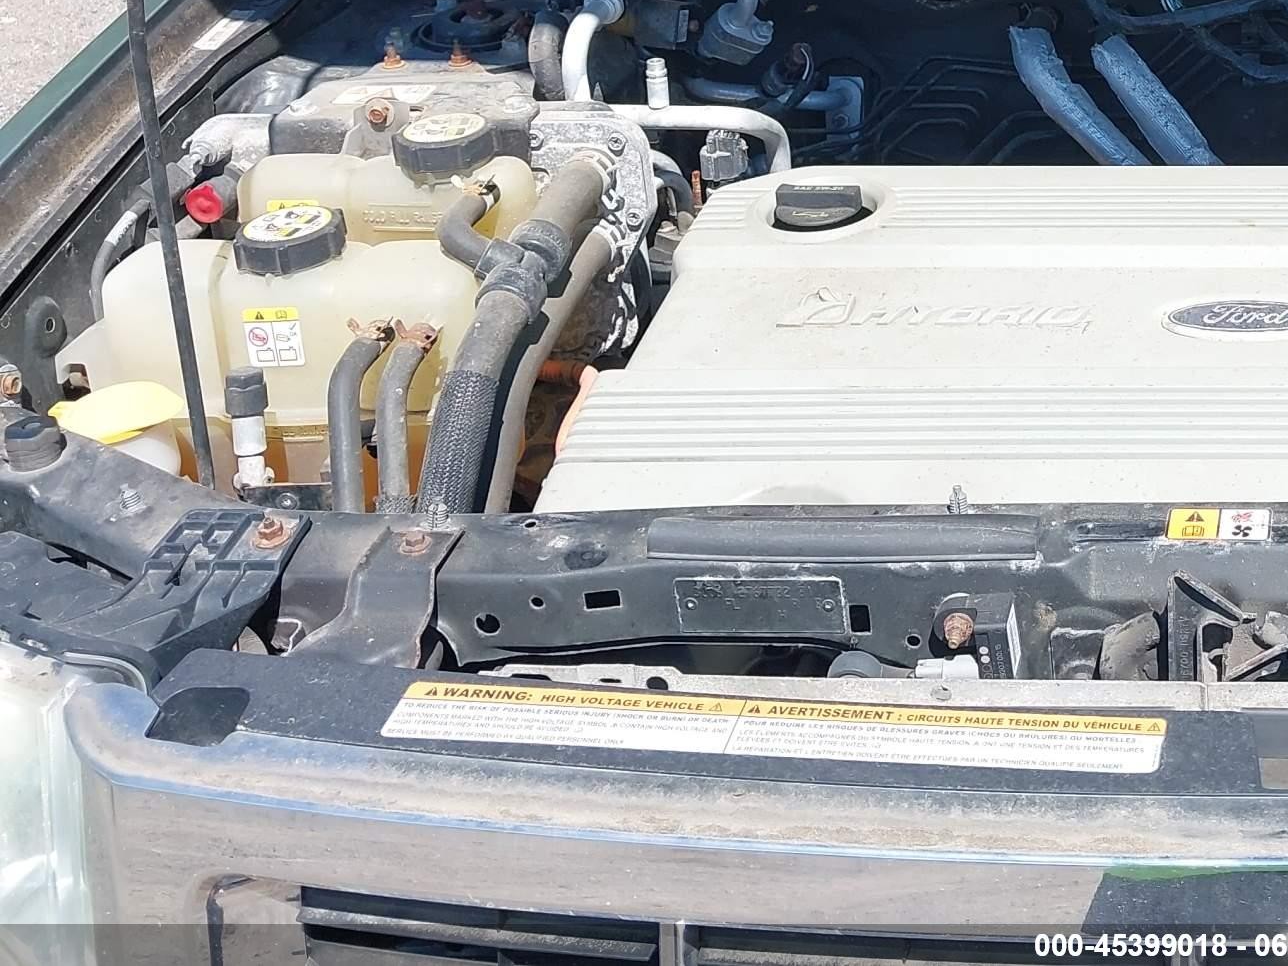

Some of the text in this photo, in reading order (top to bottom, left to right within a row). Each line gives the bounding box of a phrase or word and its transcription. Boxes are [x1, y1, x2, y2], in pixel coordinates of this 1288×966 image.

[444, 687, 704, 710] WARNING: HIGH VOLTAGE VEHICLE
[767, 704, 894, 721] AVERTISSEMENT
[906, 713, 960, 723] CIRCUITS
[964, 716, 1004, 725] HAUTE
[1008, 718, 1058, 728] TENSION
[1063, 721, 1079, 729] DU
